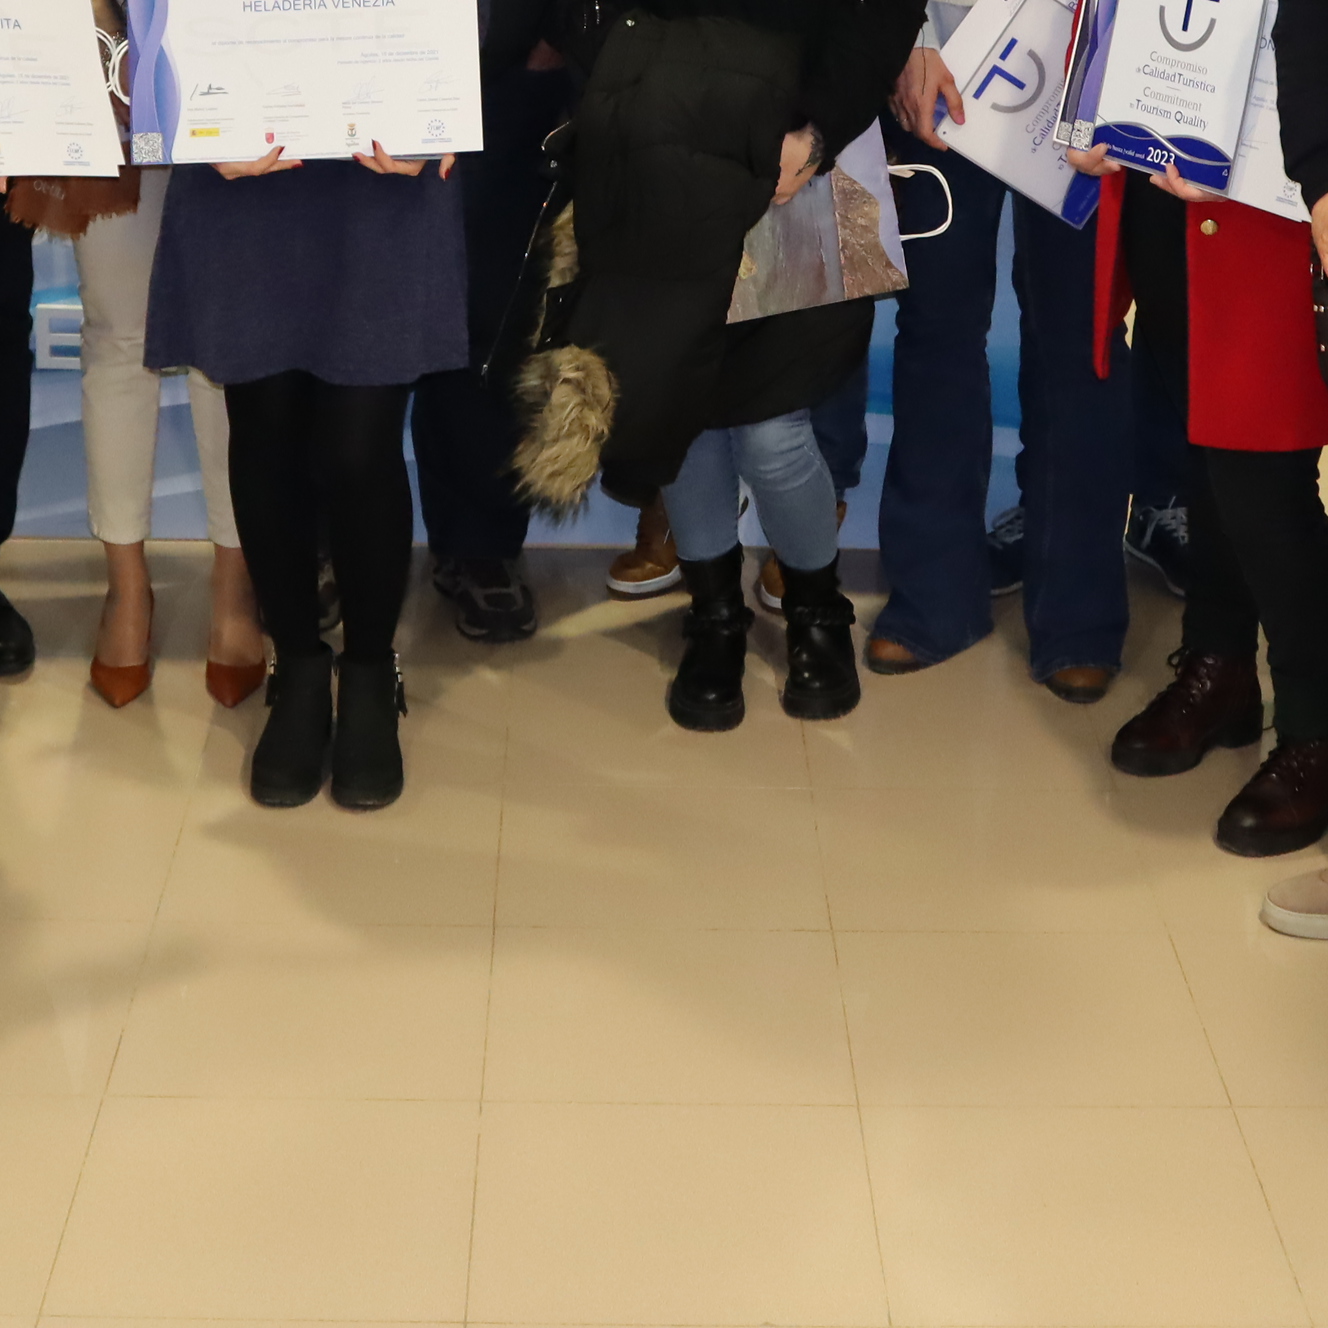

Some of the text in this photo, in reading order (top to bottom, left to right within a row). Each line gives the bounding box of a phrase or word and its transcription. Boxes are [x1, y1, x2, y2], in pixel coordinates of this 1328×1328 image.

[1149, 51, 1208, 75] Compromiso
[1143, 86, 1203, 112] Commitment
[1135, 99, 1172, 119] Tourism
[1174, 110, 1209, 131] Quality
[1146, 146, 1175, 166] 2023
